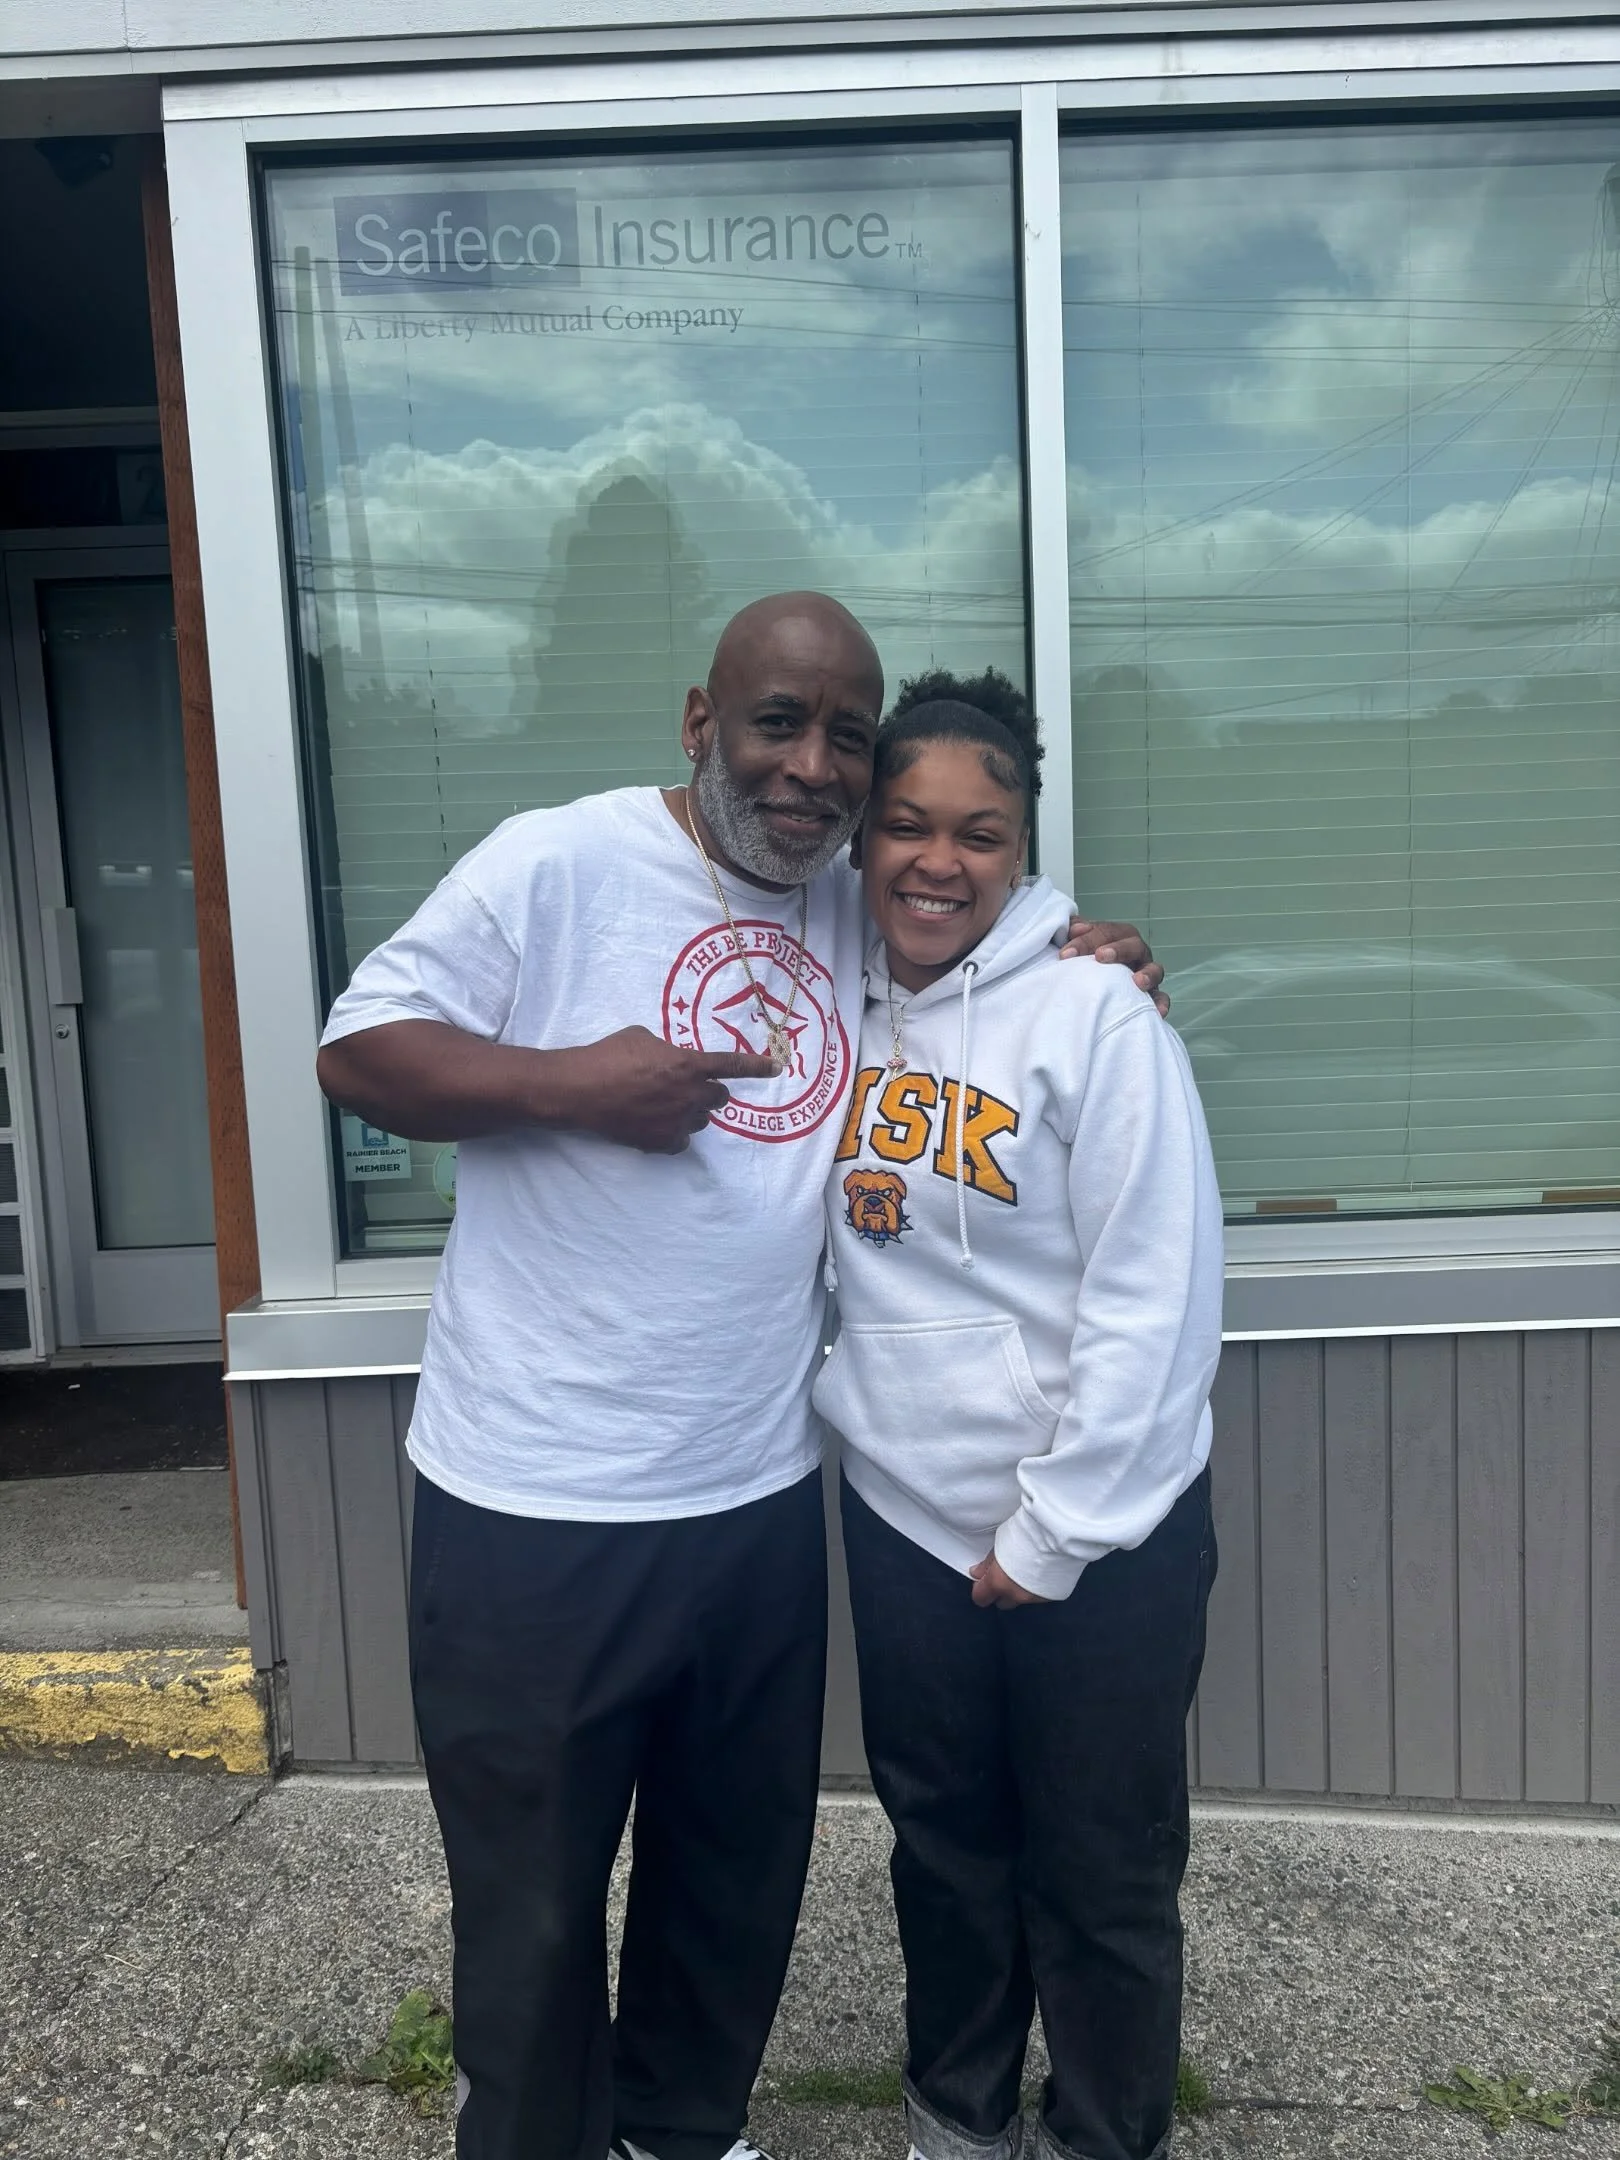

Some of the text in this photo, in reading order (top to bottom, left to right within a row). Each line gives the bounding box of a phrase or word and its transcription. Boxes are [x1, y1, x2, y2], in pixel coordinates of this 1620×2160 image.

[354, 211, 562, 277] Safeco
[594, 205, 890, 268] Insurance
[344, 304, 744, 343] A Liberty Mutual Company
[686, 940, 723, 977] THE
[720, 931, 748, 952] BE
[676, 1022, 838, 1132] A OLLEGE EXPERIENCE
[346, 1148, 407, 1158] RAINIER BEACH
[355, 1163, 401, 1173] MEMBER
